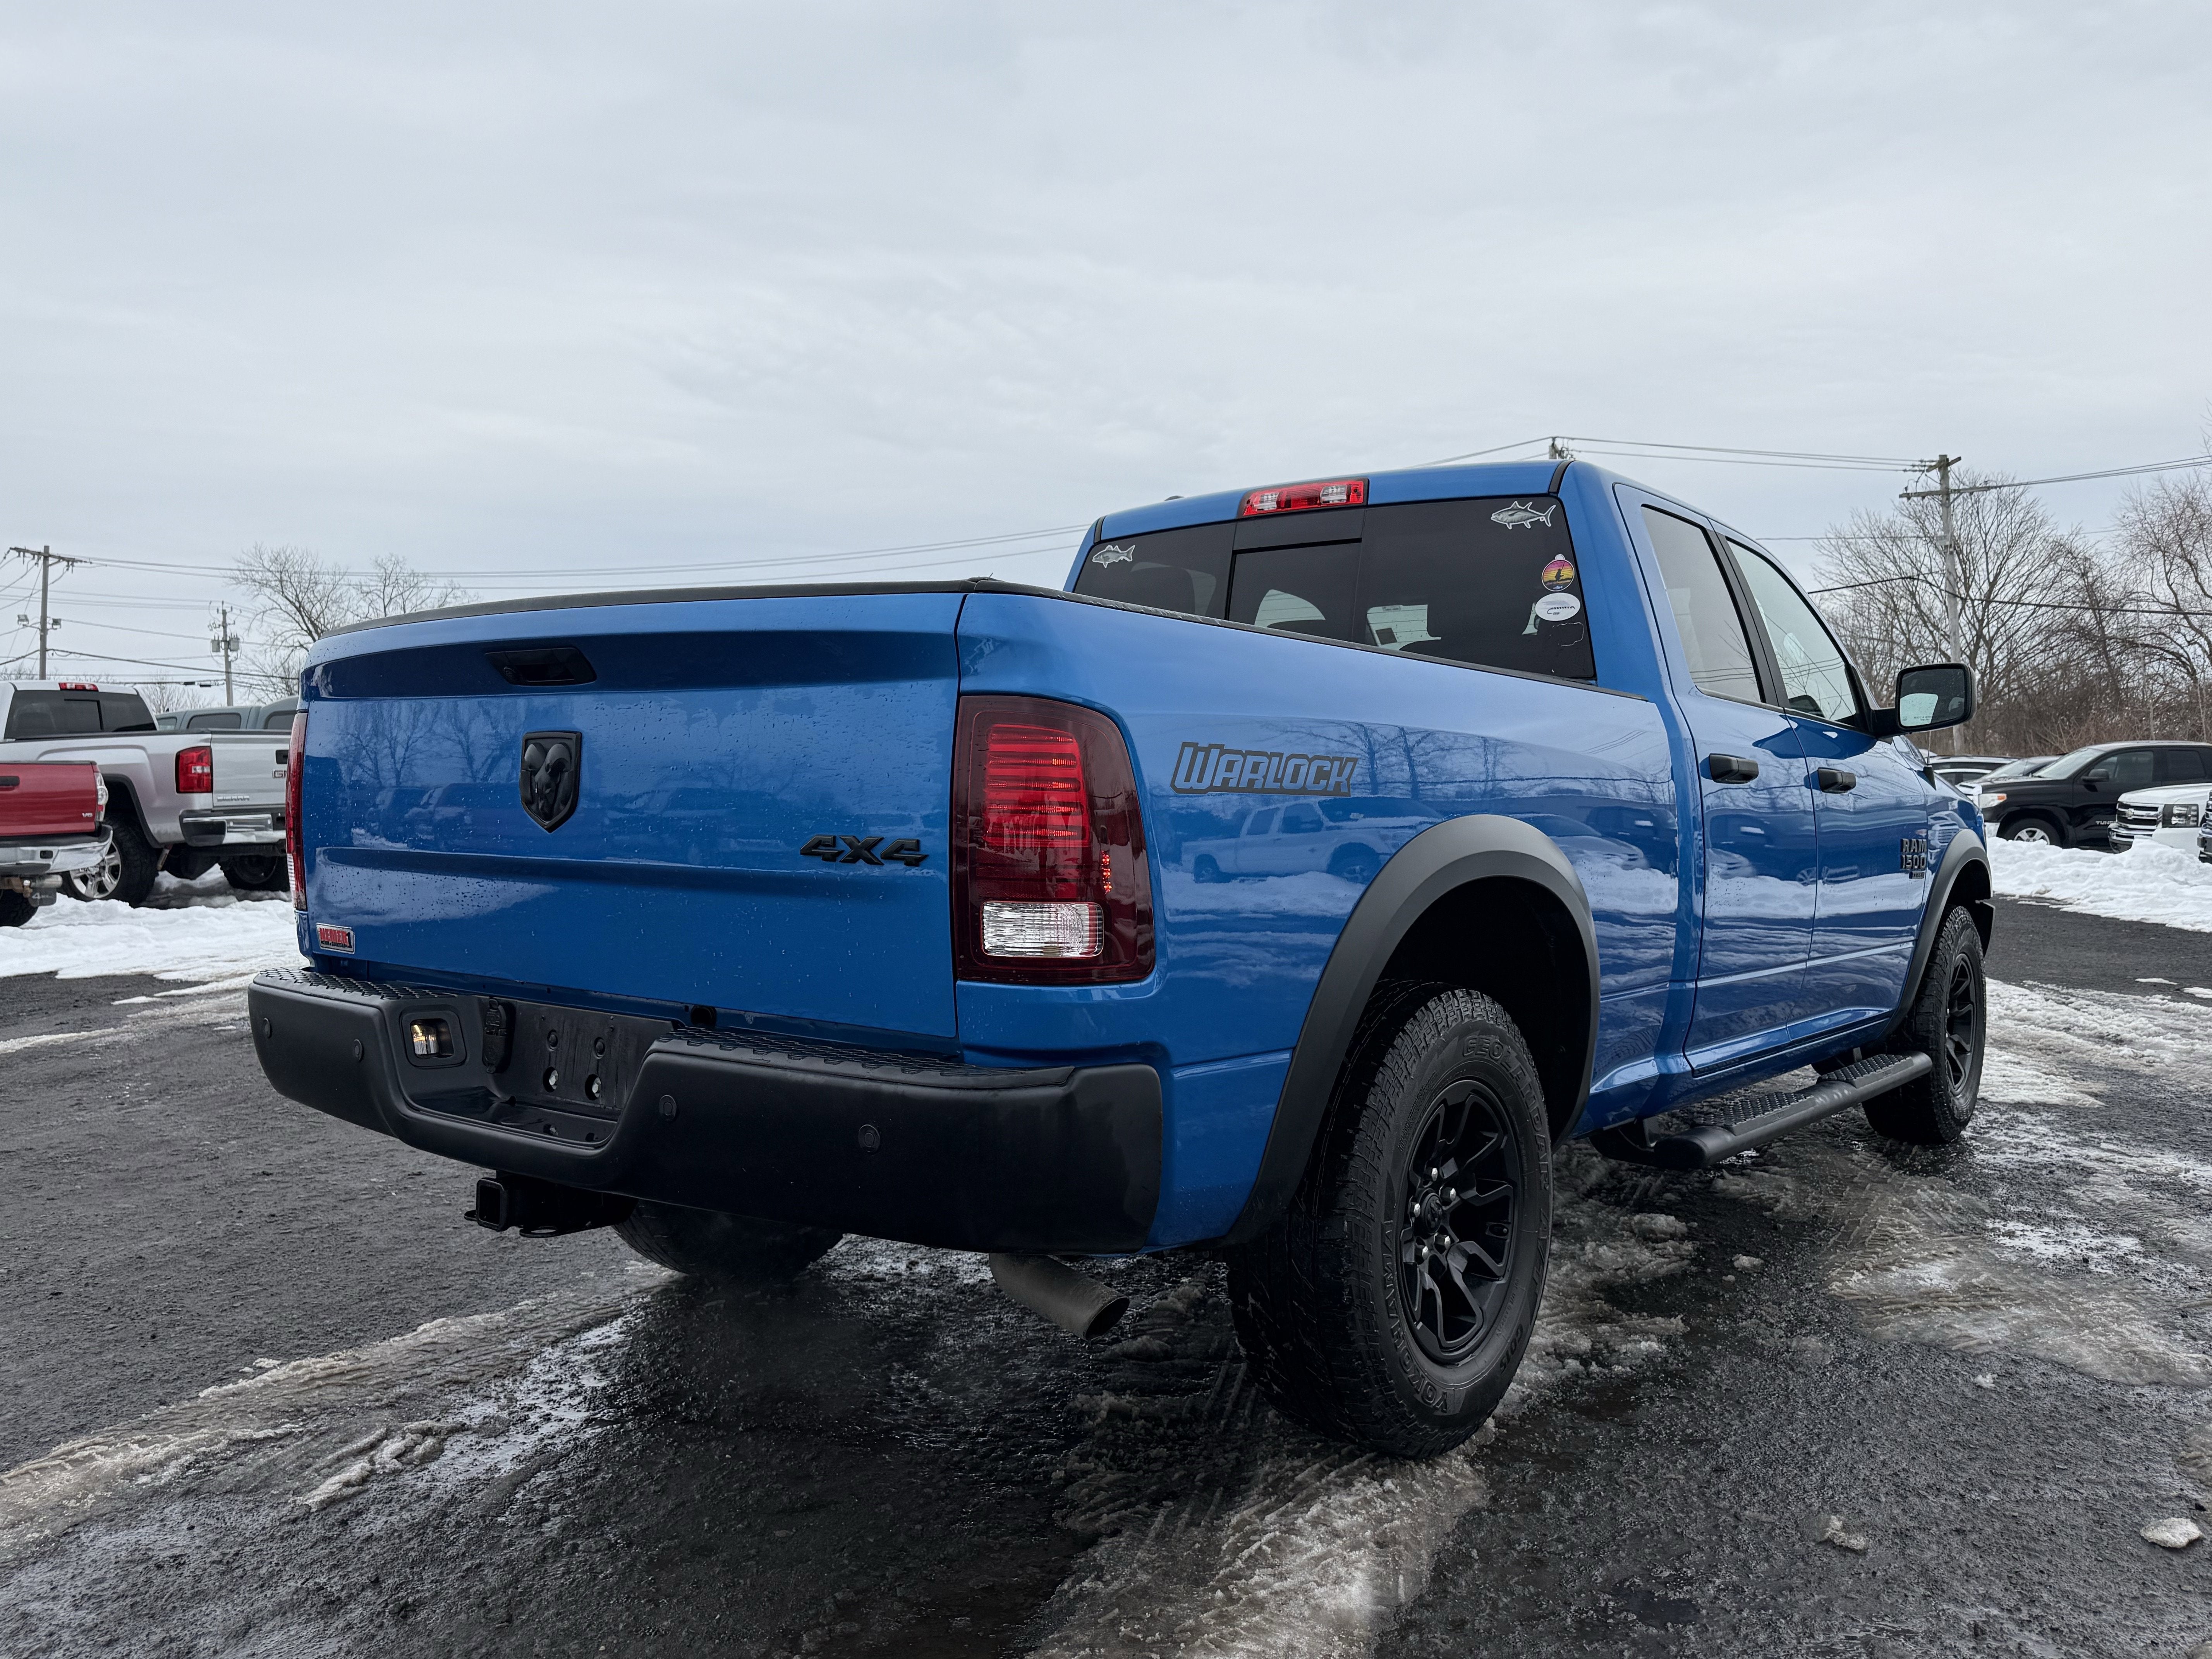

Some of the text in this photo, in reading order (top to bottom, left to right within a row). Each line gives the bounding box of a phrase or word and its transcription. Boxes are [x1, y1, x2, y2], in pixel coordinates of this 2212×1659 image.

[1170, 741, 1359, 797] WARLOCK
[1900, 838, 1927, 853] RAM
[1900, 855, 1926, 869] 1500
[1462, 1034, 1549, 1190] GEOLANDAR
[1381, 1220, 1448, 1413] YOKOHAMA
